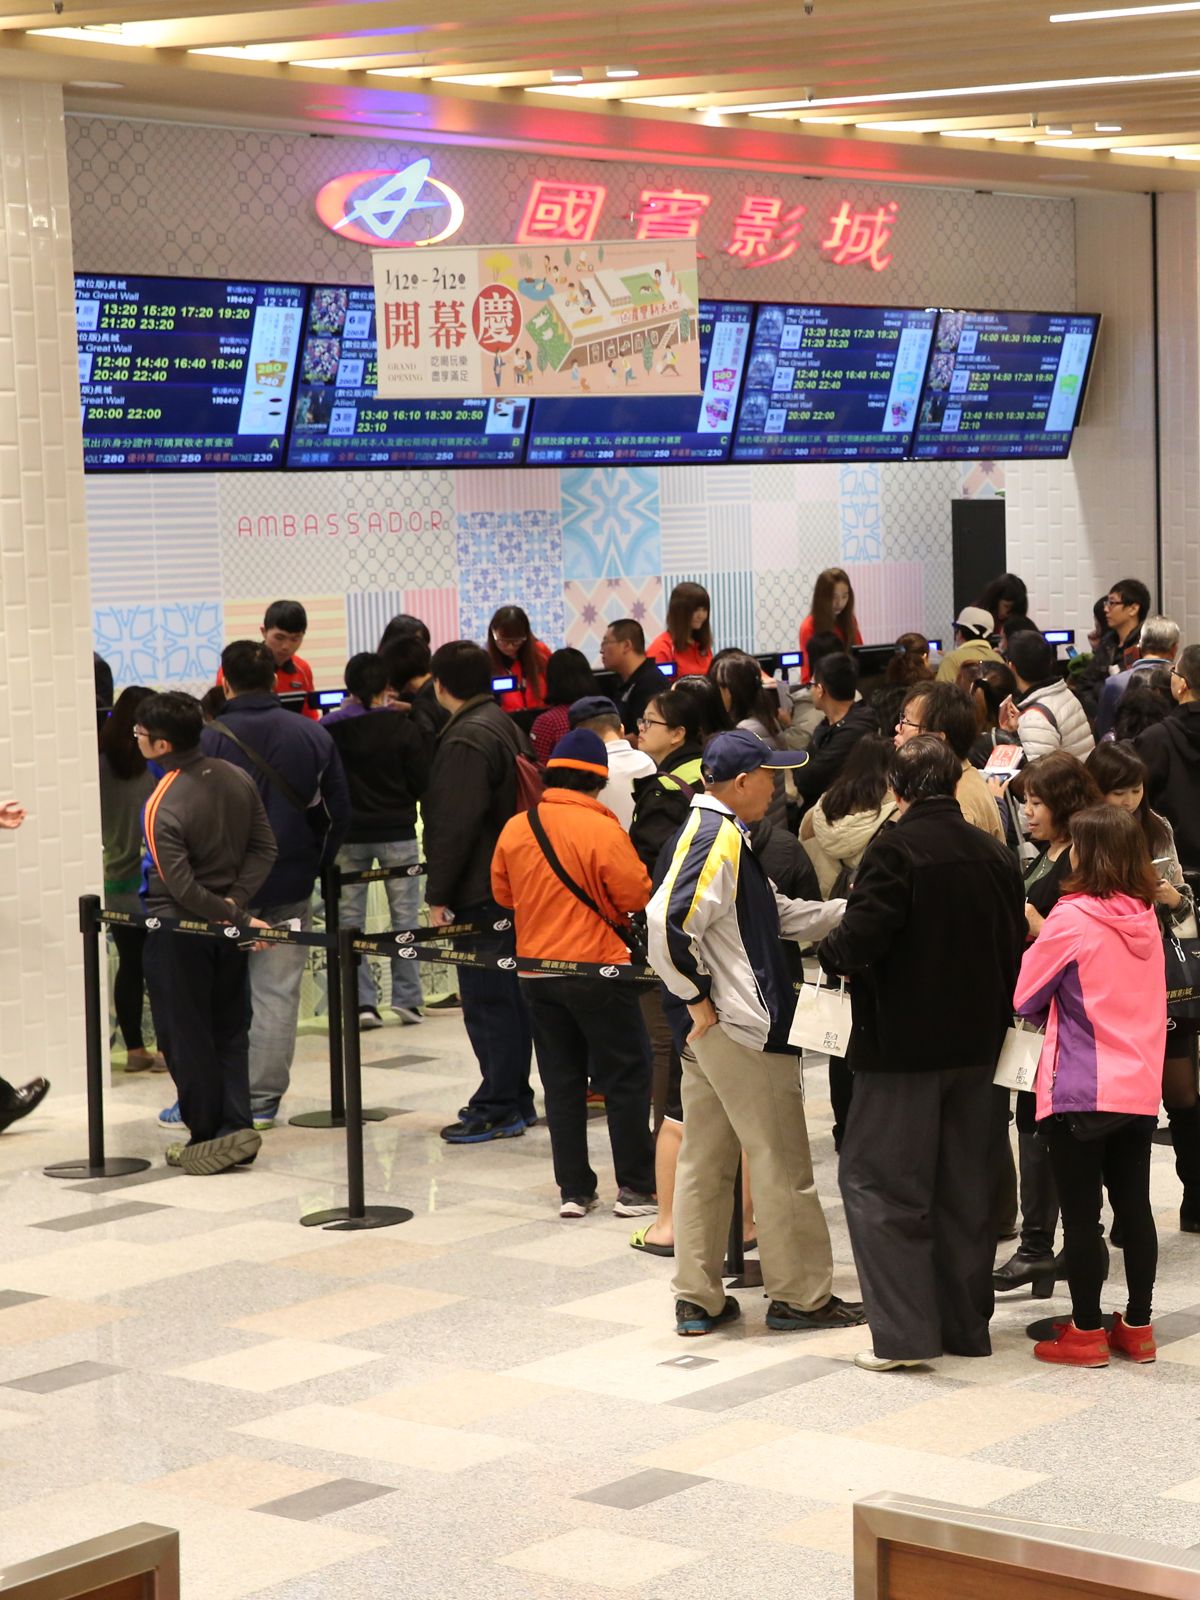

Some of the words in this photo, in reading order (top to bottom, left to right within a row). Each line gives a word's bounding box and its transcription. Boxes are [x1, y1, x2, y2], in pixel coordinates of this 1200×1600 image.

[515, 178, 902, 272] 國賓影城
[92, 291, 119, 300] Great
[120, 292, 140, 301] Wall
[103, 304, 138, 316] 13:20
[142, 305, 177, 317] 15:20
[181, 306, 214, 318] 17:20
[218, 307, 250, 319] 19:20
[100, 318, 136, 329] 21:20
[139, 319, 175, 330] 23:20
[384, 291, 515, 350] 開幕慶
[804, 328, 826, 337] 13:20
[829, 328, 851, 337] 15:20
[853, 329, 875, 338] 17:20
[878, 330, 898, 339] 19:20
[979, 334, 999, 342] 14:00
[1043, 335, 1062, 343] 21:40
[86, 343, 112, 352] Great
[113, 344, 133, 353] Wall
[801, 339, 824, 348] 21:20
[826, 339, 849, 348] 23:20
[96, 357, 131, 369] 12:40
[135, 357, 169, 370] 14:40
[173, 358, 207, 370] 16:40
[211, 359, 243, 371] 18:40
[431, 355, 468, 367] 吃喝玩樂
[387, 363, 417, 371] GRAND
[93, 370, 129, 381] 20:40
[133, 371, 167, 382] 22:40
[387, 374, 423, 382] OPENING
[796, 370, 818, 378] 12:40
[821, 370, 843, 379] 14:40
[846, 371, 866, 379] 16:40
[869, 371, 890, 380] 18:40
[1014, 373, 1033, 381] 17:20
[793, 381, 816, 389] 20:40
[818, 381, 841, 389] 22:40
[968, 383, 989, 391] 22:20
[105, 396, 125, 405] Wall
[88, 408, 123, 419] 20:00
[127, 408, 162, 419] 22:00
[360, 410, 388, 420] 13:40
[393, 410, 421, 420] 16:10
[425, 410, 453, 420] 18:30
[455, 410, 483, 420] 20:50
[788, 411, 810, 420] 20:00
[812, 411, 835, 420] 22:00
[963, 412, 982, 420] 13:40
[984, 412, 1004, 420] 16:10
[357, 423, 387, 433] 23:10
[960, 421, 980, 430] 23:10
[269, 439, 280, 449] A
[720, 436, 728, 445] C
[370, 453, 389, 461] 280
[436, 452, 454, 460] 250
[497, 451, 514, 460] 230
[598, 450, 614, 458] 280
[654, 450, 670, 458] 250
[706, 448, 722, 457] 230
[103, 453, 125, 463] 280
[180, 453, 201, 463] 250
[253, 453, 273, 462] 230
[237, 510, 443, 538] AMBASSADOR
